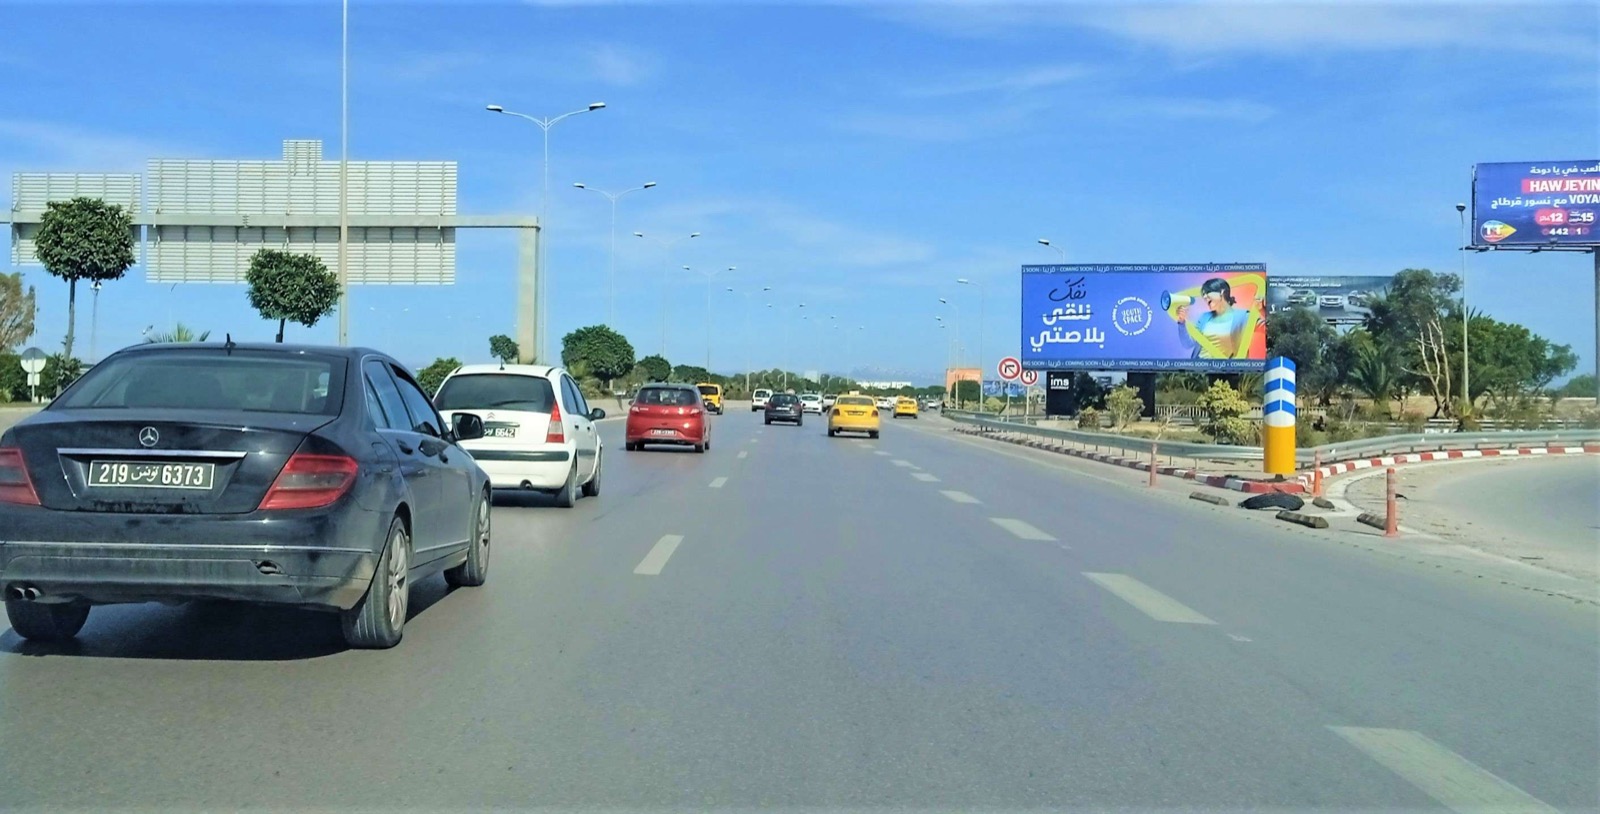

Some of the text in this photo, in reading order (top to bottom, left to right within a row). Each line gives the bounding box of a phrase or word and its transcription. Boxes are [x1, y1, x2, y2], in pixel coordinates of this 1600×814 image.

[1530, 166, 1551, 175] دوحة
[1552, 166, 1560, 175] يا
[1561, 165, 1578, 176] في
[1491, 194, 1600, 209] VOYA مع نسور قرطاج
[1550, 212, 1563, 222] 12
[1581, 212, 1595, 222] 15
[1122, 314, 1143, 325] SPACE
[1030, 327, 1105, 352] بلاصتي
[1050, 374, 1070, 386] ims
[99, 463, 204, 486] 219 تونس 6373
